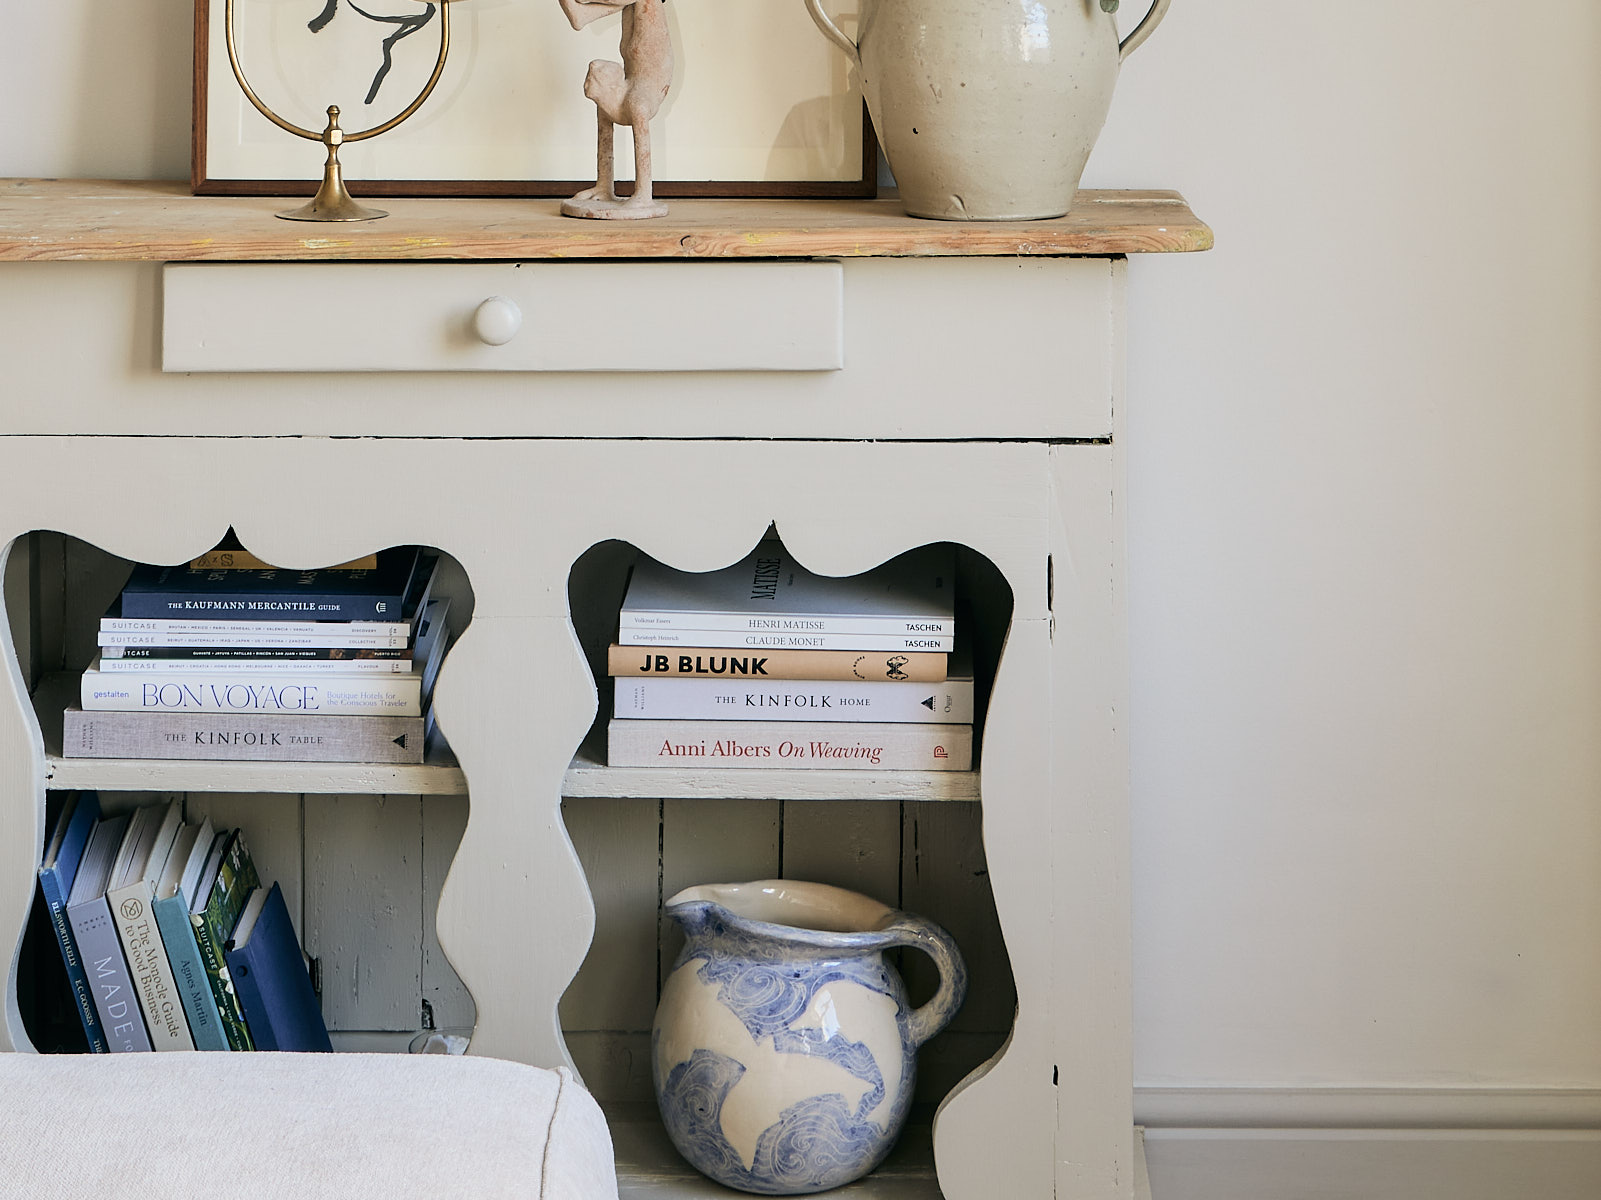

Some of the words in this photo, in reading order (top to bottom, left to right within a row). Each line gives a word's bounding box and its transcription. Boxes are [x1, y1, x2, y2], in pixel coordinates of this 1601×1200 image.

[750, 558, 781, 600] MATISSE
[185, 601, 245, 610] KAUFMANN
[248, 602, 316, 610] MERCANTILE
[112, 622, 157, 630] SUITCASE
[748, 619, 780, 629] HENRI
[783, 620, 825, 630] MATISSE
[905, 623, 942, 632] TASCHEN
[745, 636, 786, 645] CLAUDE
[788, 637, 825, 646] MONET
[904, 640, 941, 648] TASCHEN
[639, 654, 670, 672] JB
[678, 655, 769, 675] BLUNK
[93, 689, 129, 699] gestalten
[142, 683, 203, 708] BON
[210, 684, 319, 710] VOYAGE
[327, 690, 358, 700] Boutique
[360, 691, 383, 699] Hotels
[714, 696, 737, 704] THE
[745, 694, 832, 709] KINFOLK
[839, 698, 871, 706] HOME
[380, 699, 408, 707] Traveler
[164, 733, 187, 742] THE
[195, 731, 281, 746] KINFOLK
[289, 735, 324, 744] TABLE
[658, 740, 706, 756] Anni
[710, 740, 771, 758] Albers
[778, 741, 806, 758] On
[808, 742, 883, 764] Weaving
[51, 901, 70, 947] ELLSWORTH
[64, 943, 77, 967] KELLY
[125, 925, 136, 938] to
[129, 938, 145, 973] Good
[199, 926, 218, 970] SUITCASE
[137, 919, 150, 946] The
[144, 947, 168, 1000] Monocle
[161, 1001, 179, 1039] Guide
[94, 956, 134, 1037] MADE
[140, 973, 162, 1026] Business
[180, 959, 196, 990] Agnes
[191, 990, 208, 1027] Martin
